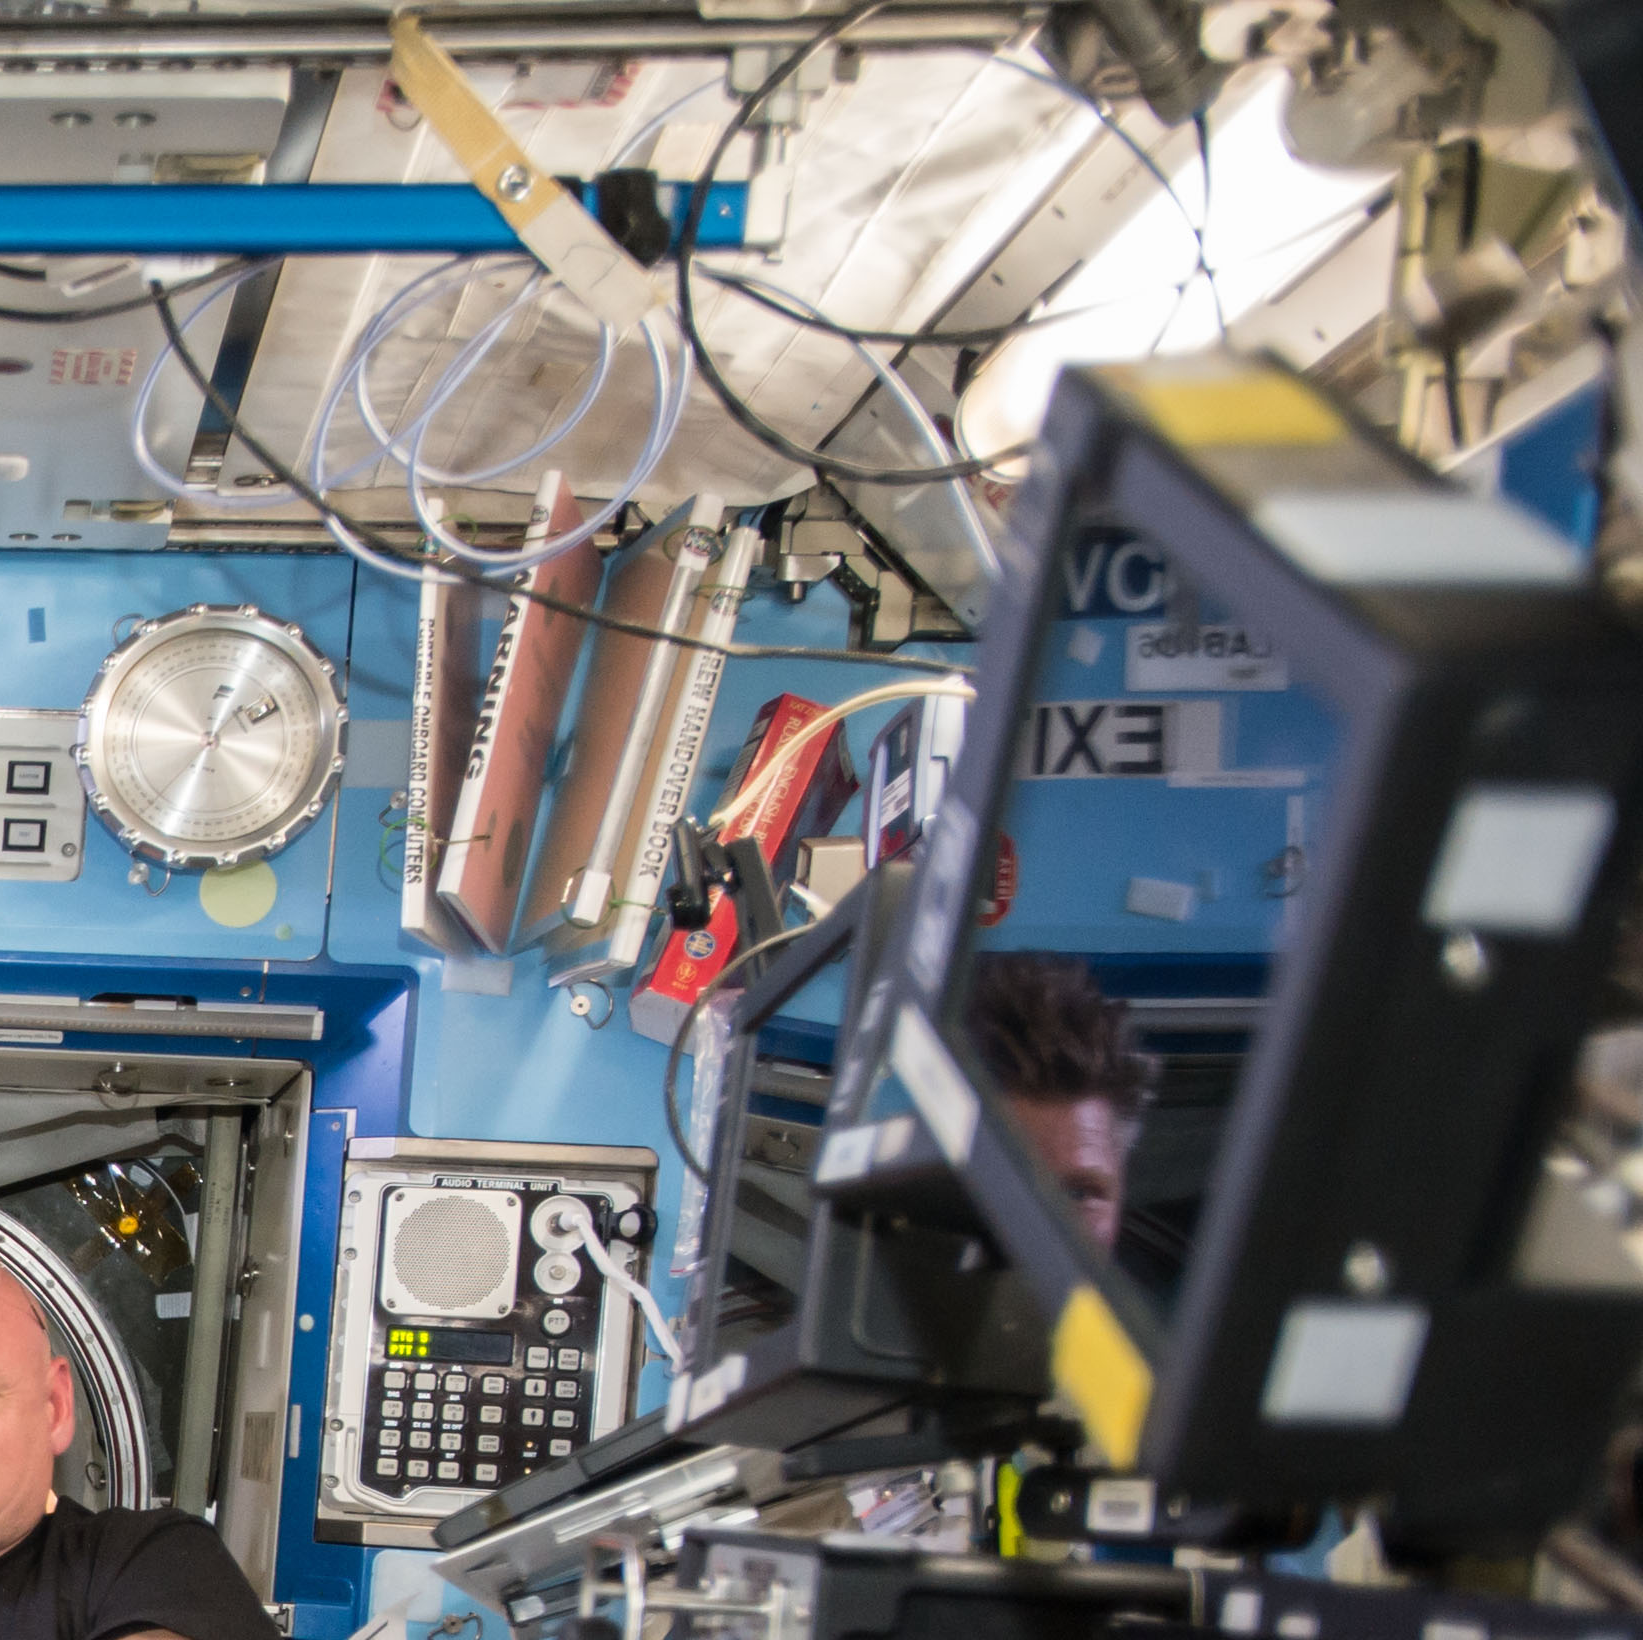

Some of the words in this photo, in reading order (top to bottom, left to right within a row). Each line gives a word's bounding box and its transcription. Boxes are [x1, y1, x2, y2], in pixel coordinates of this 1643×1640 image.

[691, 648, 724, 701] REW
[411, 704, 431, 782] ONBOARD
[655, 701, 709, 824] HANDOVER
[406, 787, 427, 884] COMPUTERS
[639, 822, 672, 879] BOOK
[441, 1178, 473, 1189] AUDIO
[477, 1179, 526, 1191] TERMINAL
[530, 1182, 554, 1192] UNIT
[548, 1317, 565, 1326] PTT
[389, 1344, 413, 1355] PTT
